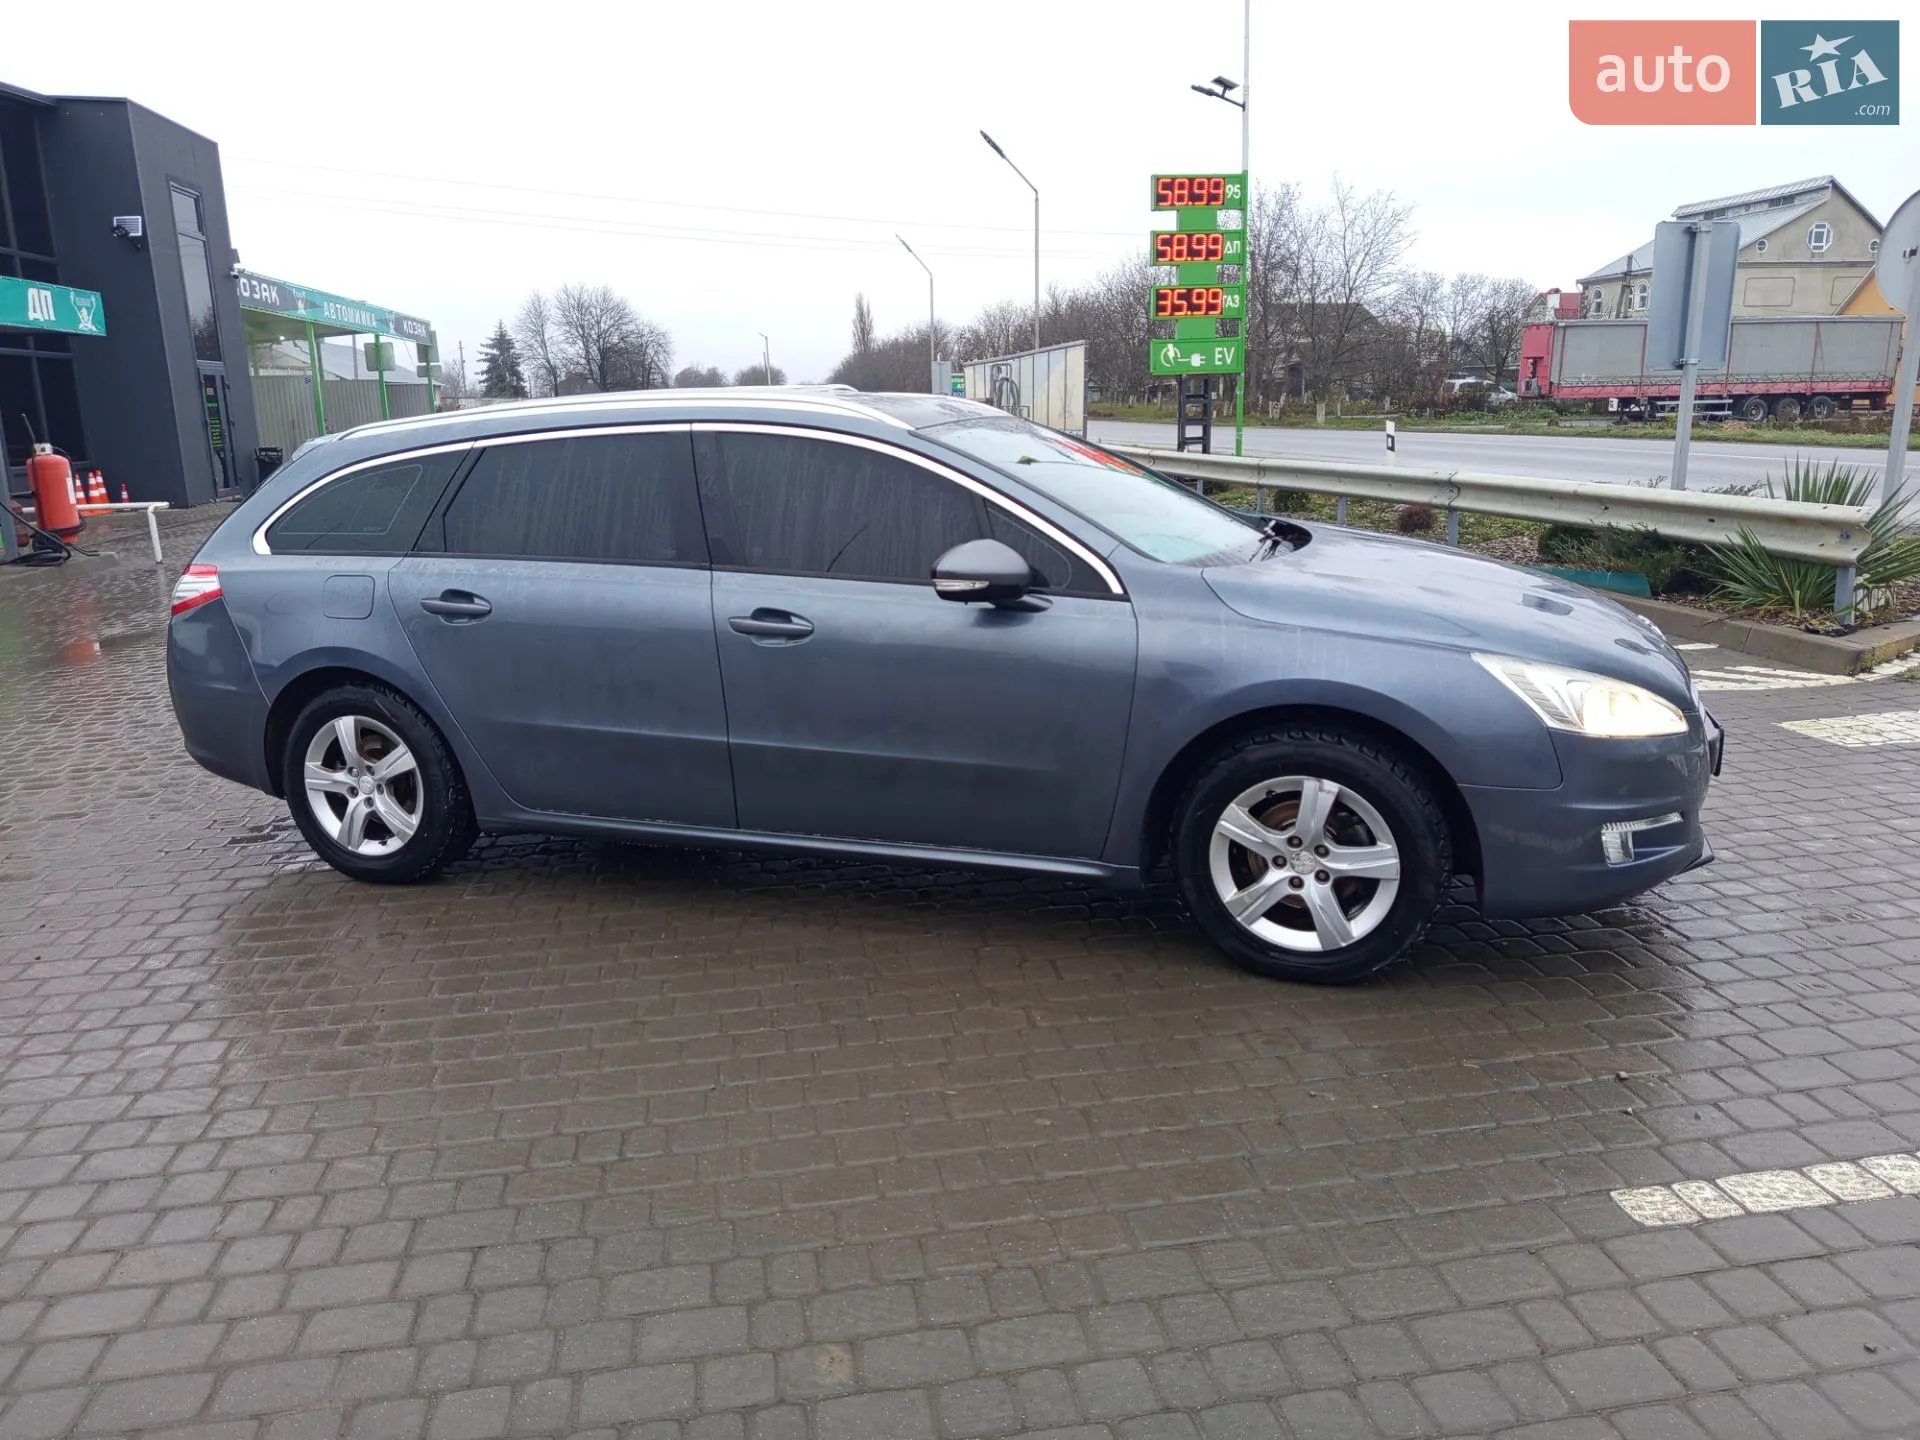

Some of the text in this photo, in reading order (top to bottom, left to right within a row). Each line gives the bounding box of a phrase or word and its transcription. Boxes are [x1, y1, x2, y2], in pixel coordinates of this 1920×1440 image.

[1158, 178, 1241, 206] 58.99 95
[1157, 233, 1241, 261] 58.99 ДП
[28, 287, 56, 322] ДП
[236, 277, 280, 306] ОЗАК
[1157, 288, 1222, 316] 35.99
[323, 300, 377, 328] АВТОМИЙКА
[402, 319, 427, 338] КОЗАК
[1215, 347, 1235, 365] EV
